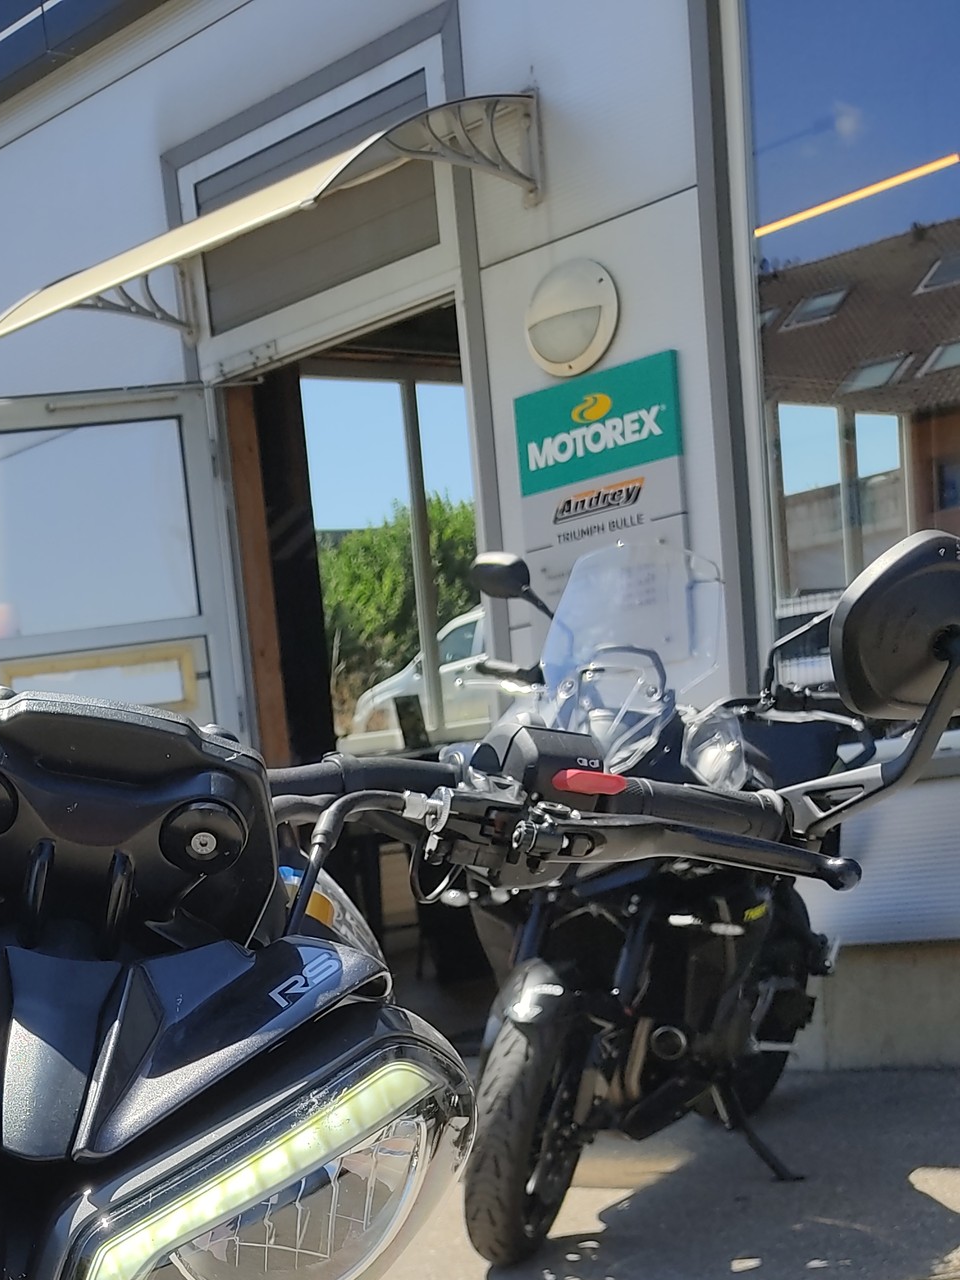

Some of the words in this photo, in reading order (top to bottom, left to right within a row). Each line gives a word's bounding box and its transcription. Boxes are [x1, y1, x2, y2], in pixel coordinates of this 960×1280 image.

[527, 404, 664, 472] MOTOREX
[558, 483, 642, 518] Andrey
[557, 523, 606, 544] TRIUMPH
[607, 513, 645, 533] BULLE
[268, 952, 342, 1009] RS
